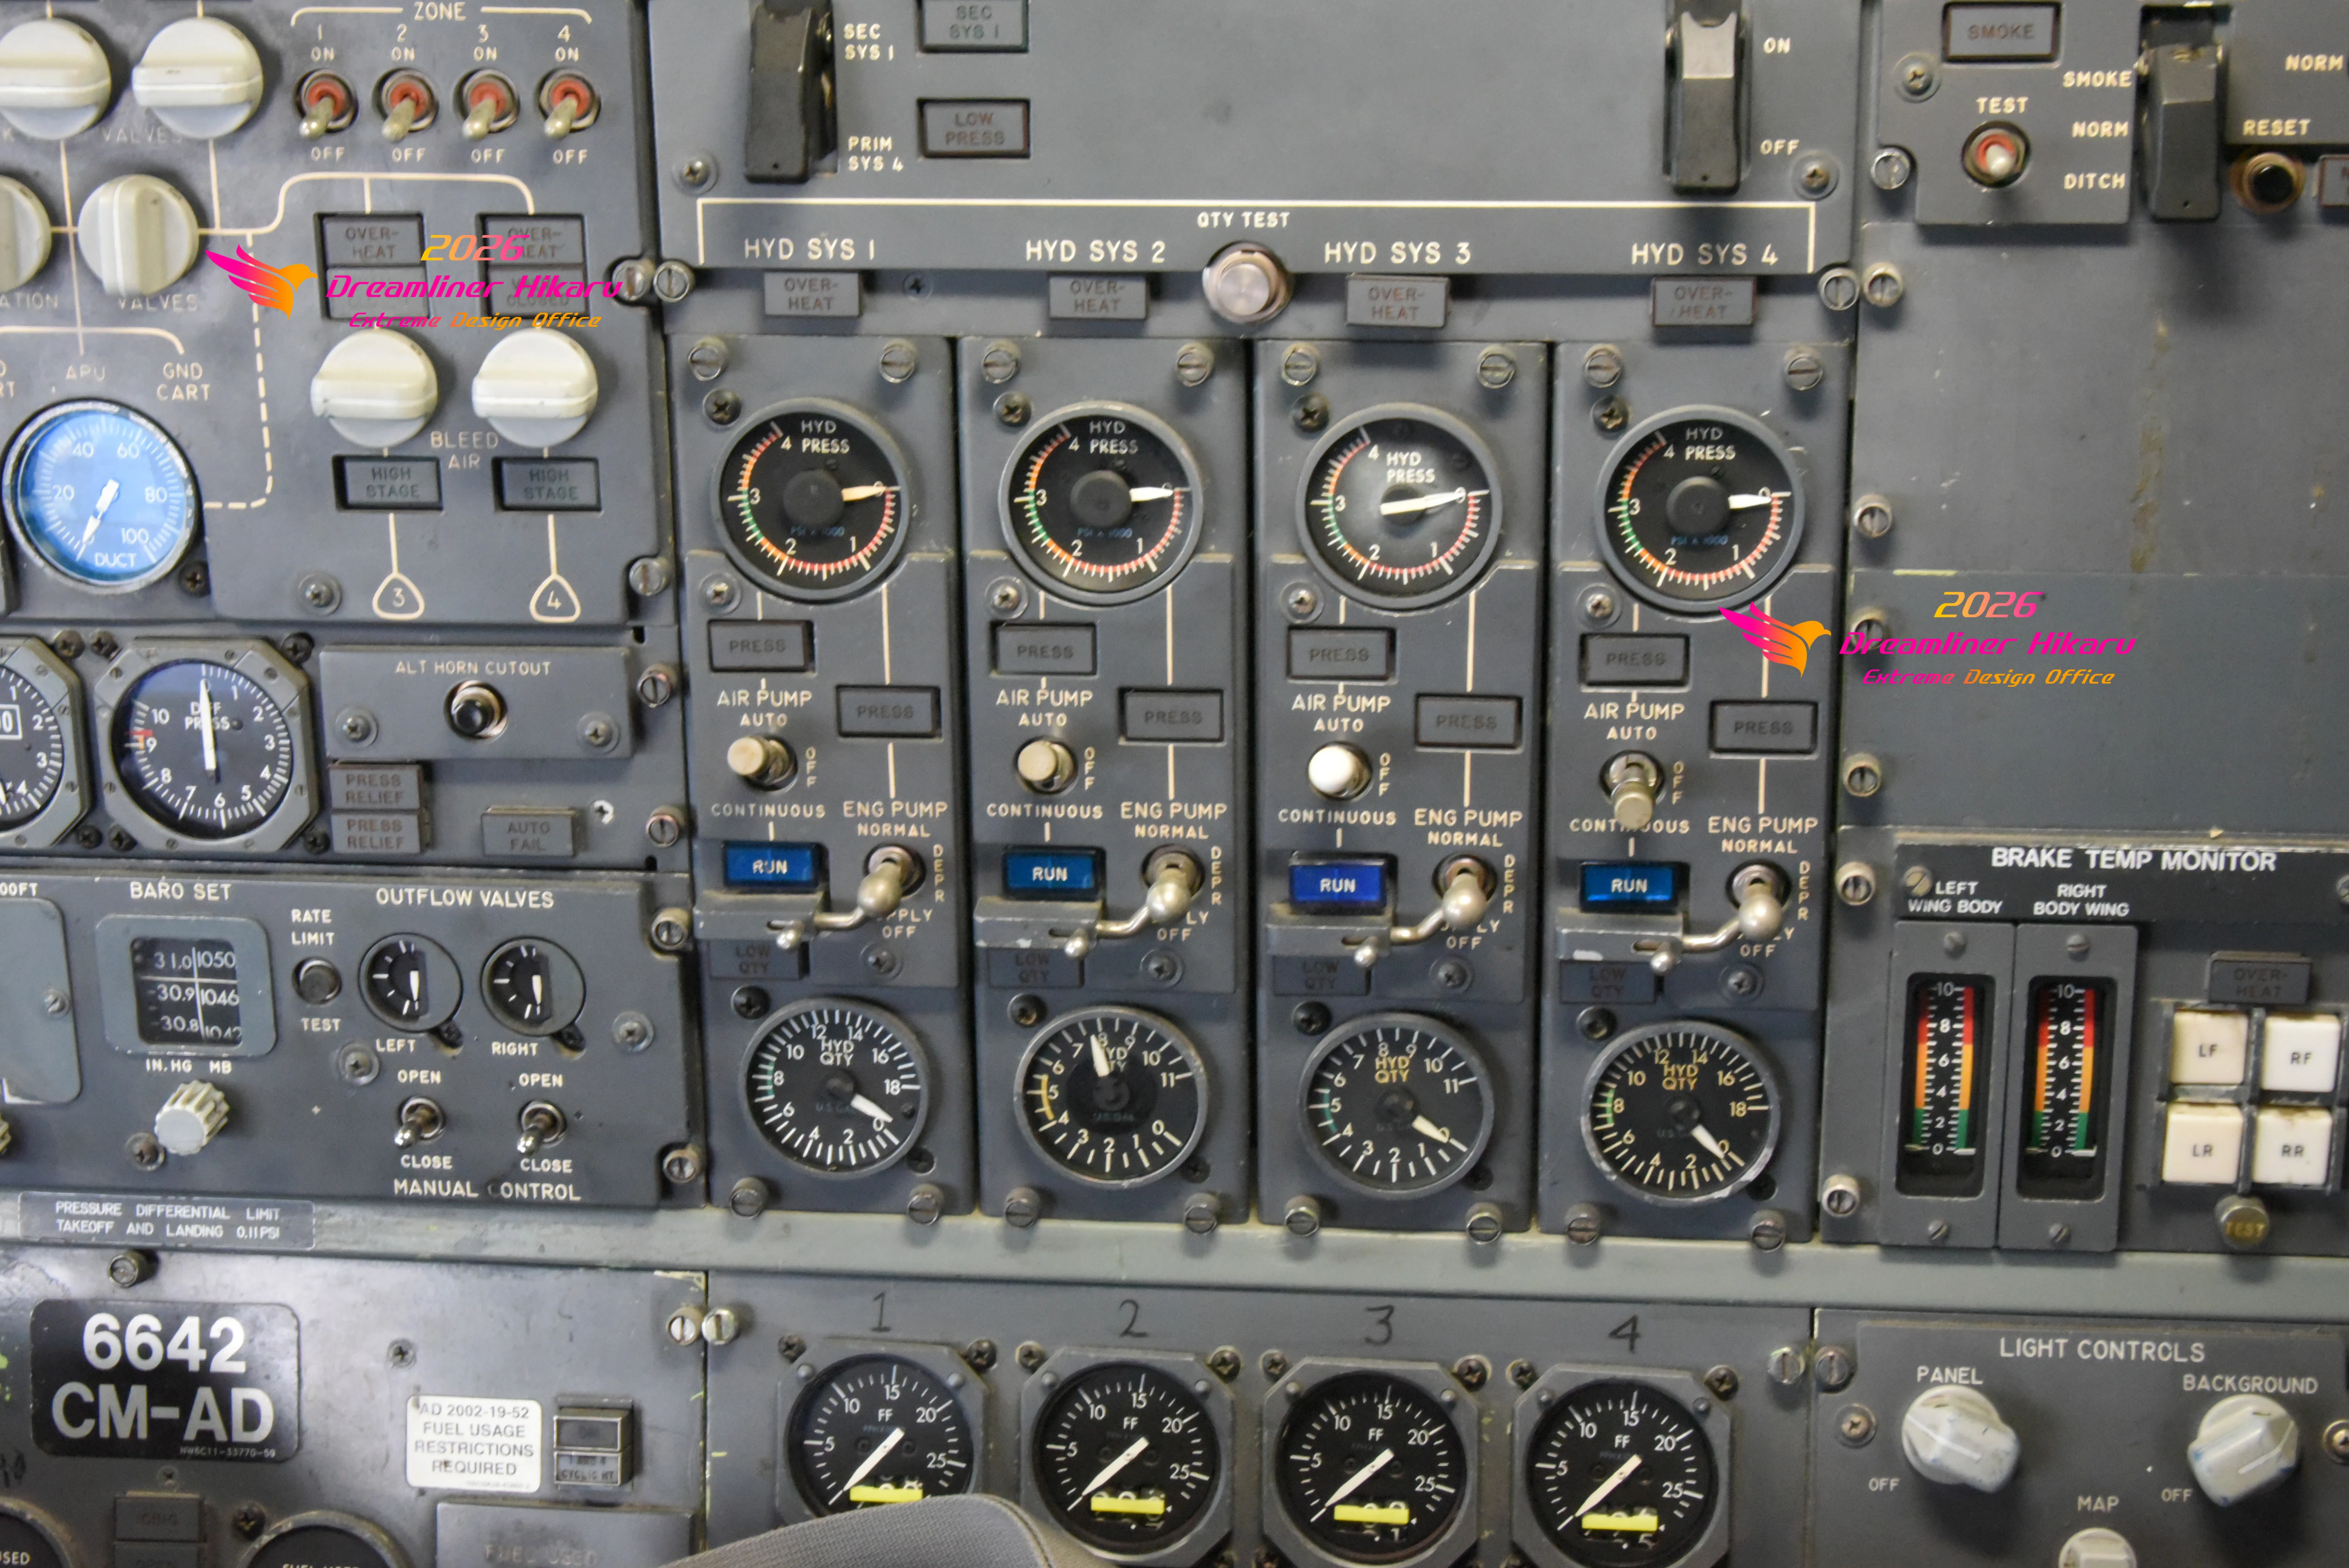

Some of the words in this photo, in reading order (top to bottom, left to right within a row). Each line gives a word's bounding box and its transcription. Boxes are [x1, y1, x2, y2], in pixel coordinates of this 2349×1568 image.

[413, 2, 466, 21] ZONE
[317, 25, 322, 40] 1
[397, 24, 408, 42] 2
[478, 25, 489, 42] 3
[558, 25, 570, 42] 4
[844, 24, 880, 40] SEC
[1968, 25, 2035, 40] SMOKE
[312, 47, 335, 60] ON
[844, 45, 880, 60] SYS
[889, 46, 894, 60] 1
[1763, 38, 1790, 54] ON
[556, 48, 579, 61] ON
[2285, 55, 2343, 71] NORM
[2063, 71, 2132, 87] SMOKE
[1976, 97, 2028, 114] TEST
[955, 112, 993, 126] LOW
[2072, 121, 2129, 137] NORM
[2243, 119, 2311, 136] RESET
[848, 137, 892, 151] PRIM
[945, 131, 1005, 145] PRESS
[312, 147, 345, 160] OFF
[1760, 140, 1799, 155] OFF
[553, 149, 588, 164] OFF
[848, 157, 883, 171] SYS
[893, 157, 903, 172] 4
[2064, 173, 2126, 189] DITCH
[1197, 211, 1234, 228] QTY
[1242, 212, 1290, 228] TEST
[744, 238, 794, 259] HYD
[808, 239, 855, 259] SYS
[1026, 240, 1076, 262] HYD
[1090, 241, 1137, 262] SYS
[1151, 242, 1166, 263] 2
[1325, 242, 1376, 264] HYD
[1391, 242, 1441, 264] SYS
[1456, 243, 1471, 264] 3
[1631, 243, 1684, 265] HYD
[1698, 243, 1747, 265] SYS
[1761, 245, 1779, 265] 4
[1369, 287, 1426, 302] OVER-
[1371, 306, 1420, 321] HEAT
[66, 365, 105, 380] APU
[163, 362, 203, 380] GND
[157, 384, 210, 400] CART
[430, 431, 499, 449] BLEED
[72, 442, 94, 458] 40
[117, 444, 139, 459] 60
[448, 454, 480, 469] AIR
[1387, 452, 1421, 466] HYD
[372, 467, 411, 481] HIGH
[1387, 469, 1435, 483] PRESS
[52, 485, 75, 501] 20
[144, 487, 167, 503] 80
[366, 485, 420, 499] STAGE
[121, 527, 149, 544] 100
[95, 552, 137, 568] DUCT
[396, 661, 426, 675] ALT
[434, 662, 478, 675] HORN
[485, 662, 551, 675] CUTOUT
[717, 691, 750, 707] AIR
[757, 691, 812, 707] PUMP
[1584, 703, 1618, 719] AIR
[1626, 703, 1685, 720] PUMP
[1314, 718, 1363, 732] AUTO
[346, 774, 401, 786] PRESS
[346, 791, 404, 804] RELIEF
[711, 804, 825, 818] CONTINUOUS
[1121, 802, 1162, 819] ENG
[1171, 802, 1227, 820] PUMP
[508, 821, 551, 833] AUTO
[511, 839, 545, 851] FAIL
[1428, 832, 1503, 847] NORMAL
[753, 860, 788, 873] RUN
[1991, 848, 2072, 869] BRAKE
[2086, 850, 2153, 869] TEMP
[2162, 851, 2276, 871] MONITOR
[1033, 867, 1068, 882] RUN
[130, 882, 184, 899] BARO
[194, 882, 232, 901] SET
[1320, 878, 1355, 893] RUN
[1611, 878, 1647, 893] RUN
[1936, 882, 1978, 895] LEFT
[2058, 884, 2107, 898] RIGHT
[376, 889, 472, 906] OUTFLOW
[480, 890, 554, 908] VALVES
[1908, 900, 1952, 913] WING
[1957, 900, 2003, 914] BODY
[2034, 902, 2080, 916] BODY
[2085, 903, 2130, 917] WING
[291, 909, 331, 923] RATE
[291, 932, 334, 945] LIMIT
[197, 951, 236, 968] 1050
[157, 984, 195, 1001] 30.9
[201, 989, 240, 1006] 1046
[301, 1018, 340, 1032] TEST
[376, 1039, 416, 1052] LEFT
[492, 1042, 538, 1055] RIGHT
[822, 1040, 854, 1053] HYD
[2199, 1044, 2217, 1057] LF
[820, 1054, 854, 1066] QTY
[2291, 1052, 2311, 1064] RF
[209, 1060, 232, 1074] MB
[398, 1070, 441, 1084] OPEN
[2193, 1144, 2213, 1156] LR
[2282, 1145, 2304, 1156] RR
[401, 1155, 452, 1169] CLOSE
[520, 1159, 572, 1172] CLOSE
[394, 1180, 478, 1197] MANUAL
[56, 1202, 121, 1216] PRESSURE
[136, 1205, 230, 1219] DIFFERENTIAL
[246, 1208, 280, 1221] LIMIT
[56, 1220, 114, 1234] TAKEOFF
[126, 1222, 154, 1235] AND
[166, 1223, 223, 1238] LANDING
[872, 1292, 891, 1332] 1
[1119, 1299, 1148, 1337] 2
[1364, 1305, 1394, 1345] 3
[1608, 1314, 1641, 1354] 4
[83, 1313, 246, 1374] 6642
[2000, 1337, 2068, 1358] LIGHT
[2077, 1340, 2205, 1363] CONTROLS
[1917, 1366, 1983, 1384] PANEL
[2183, 1374, 2319, 1394] BACKGROUND
[52, 1381, 274, 1443] CM-AD
[419, 1404, 442, 1416] AD
[447, 1404, 529, 1418] 2002-19-52
[1623, 1410, 1640, 1425] 15
[423, 1422, 464, 1435] FUEL
[469, 1424, 525, 1438] USAGE
[414, 1440, 534, 1457] RESTRICTIONS
[1615, 1435, 1630, 1447] FF
[431, 1460, 516, 1475] REQUIRED
[1869, 1478, 1900, 1491] OFF
[2162, 1488, 2192, 1502] OFF
[2078, 1496, 2119, 1511] MAP
